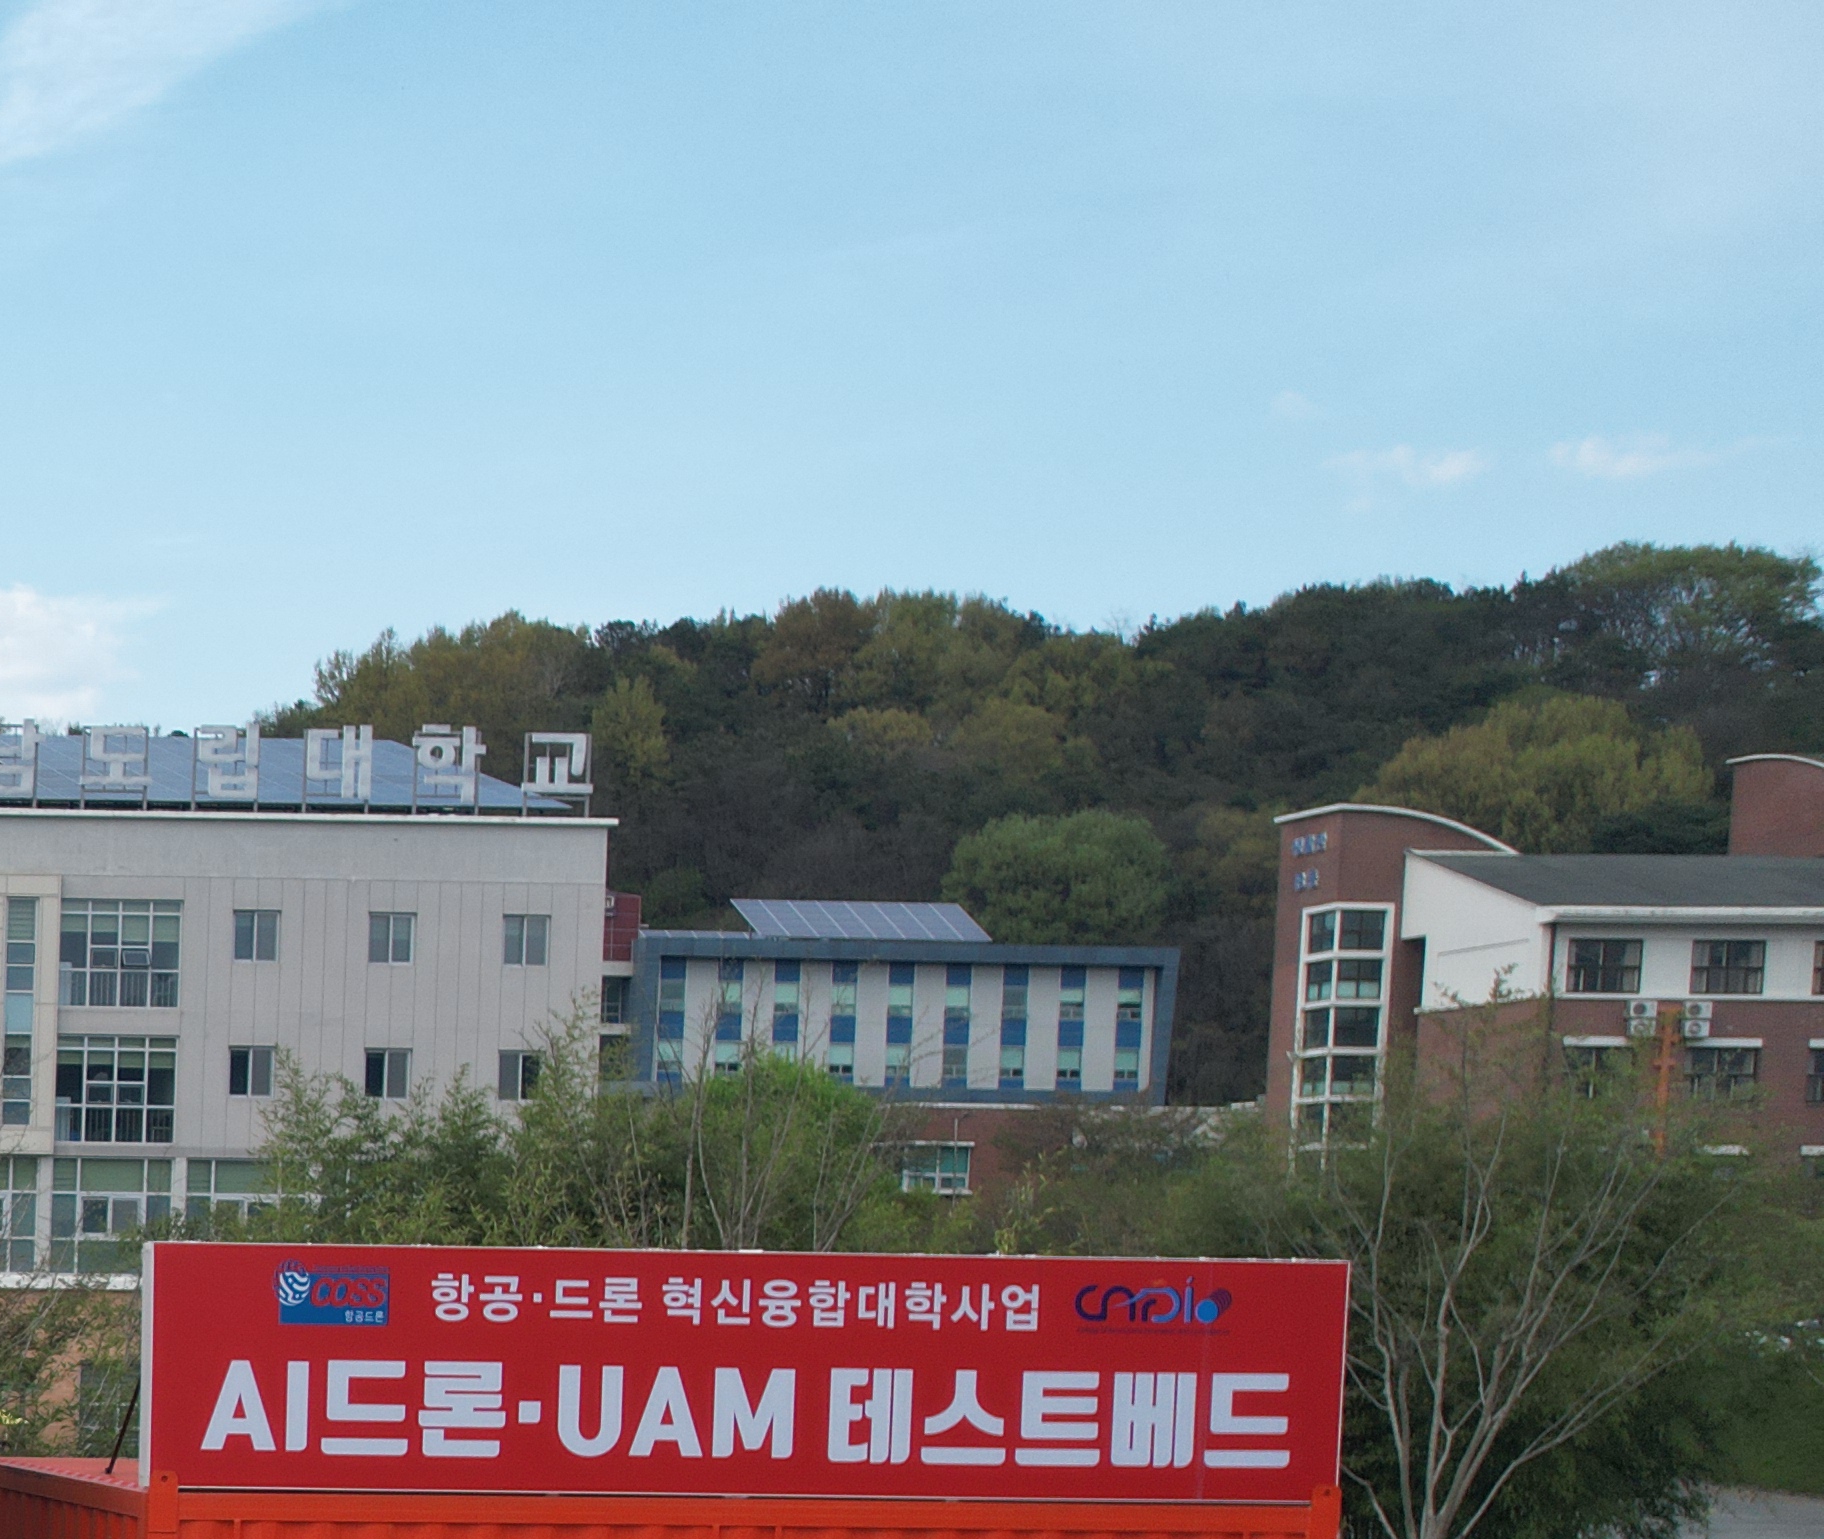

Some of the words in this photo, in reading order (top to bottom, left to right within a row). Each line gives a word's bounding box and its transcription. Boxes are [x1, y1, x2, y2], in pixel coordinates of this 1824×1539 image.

[310, 1277, 387, 1308] COSS
[431, 1272, 643, 1324] 항공·드론
[662, 1277, 1040, 1332] 혁신융합대학사업
[345, 1310, 384, 1323] 항공드론
[827, 1367, 1291, 1469] 테스트베드
